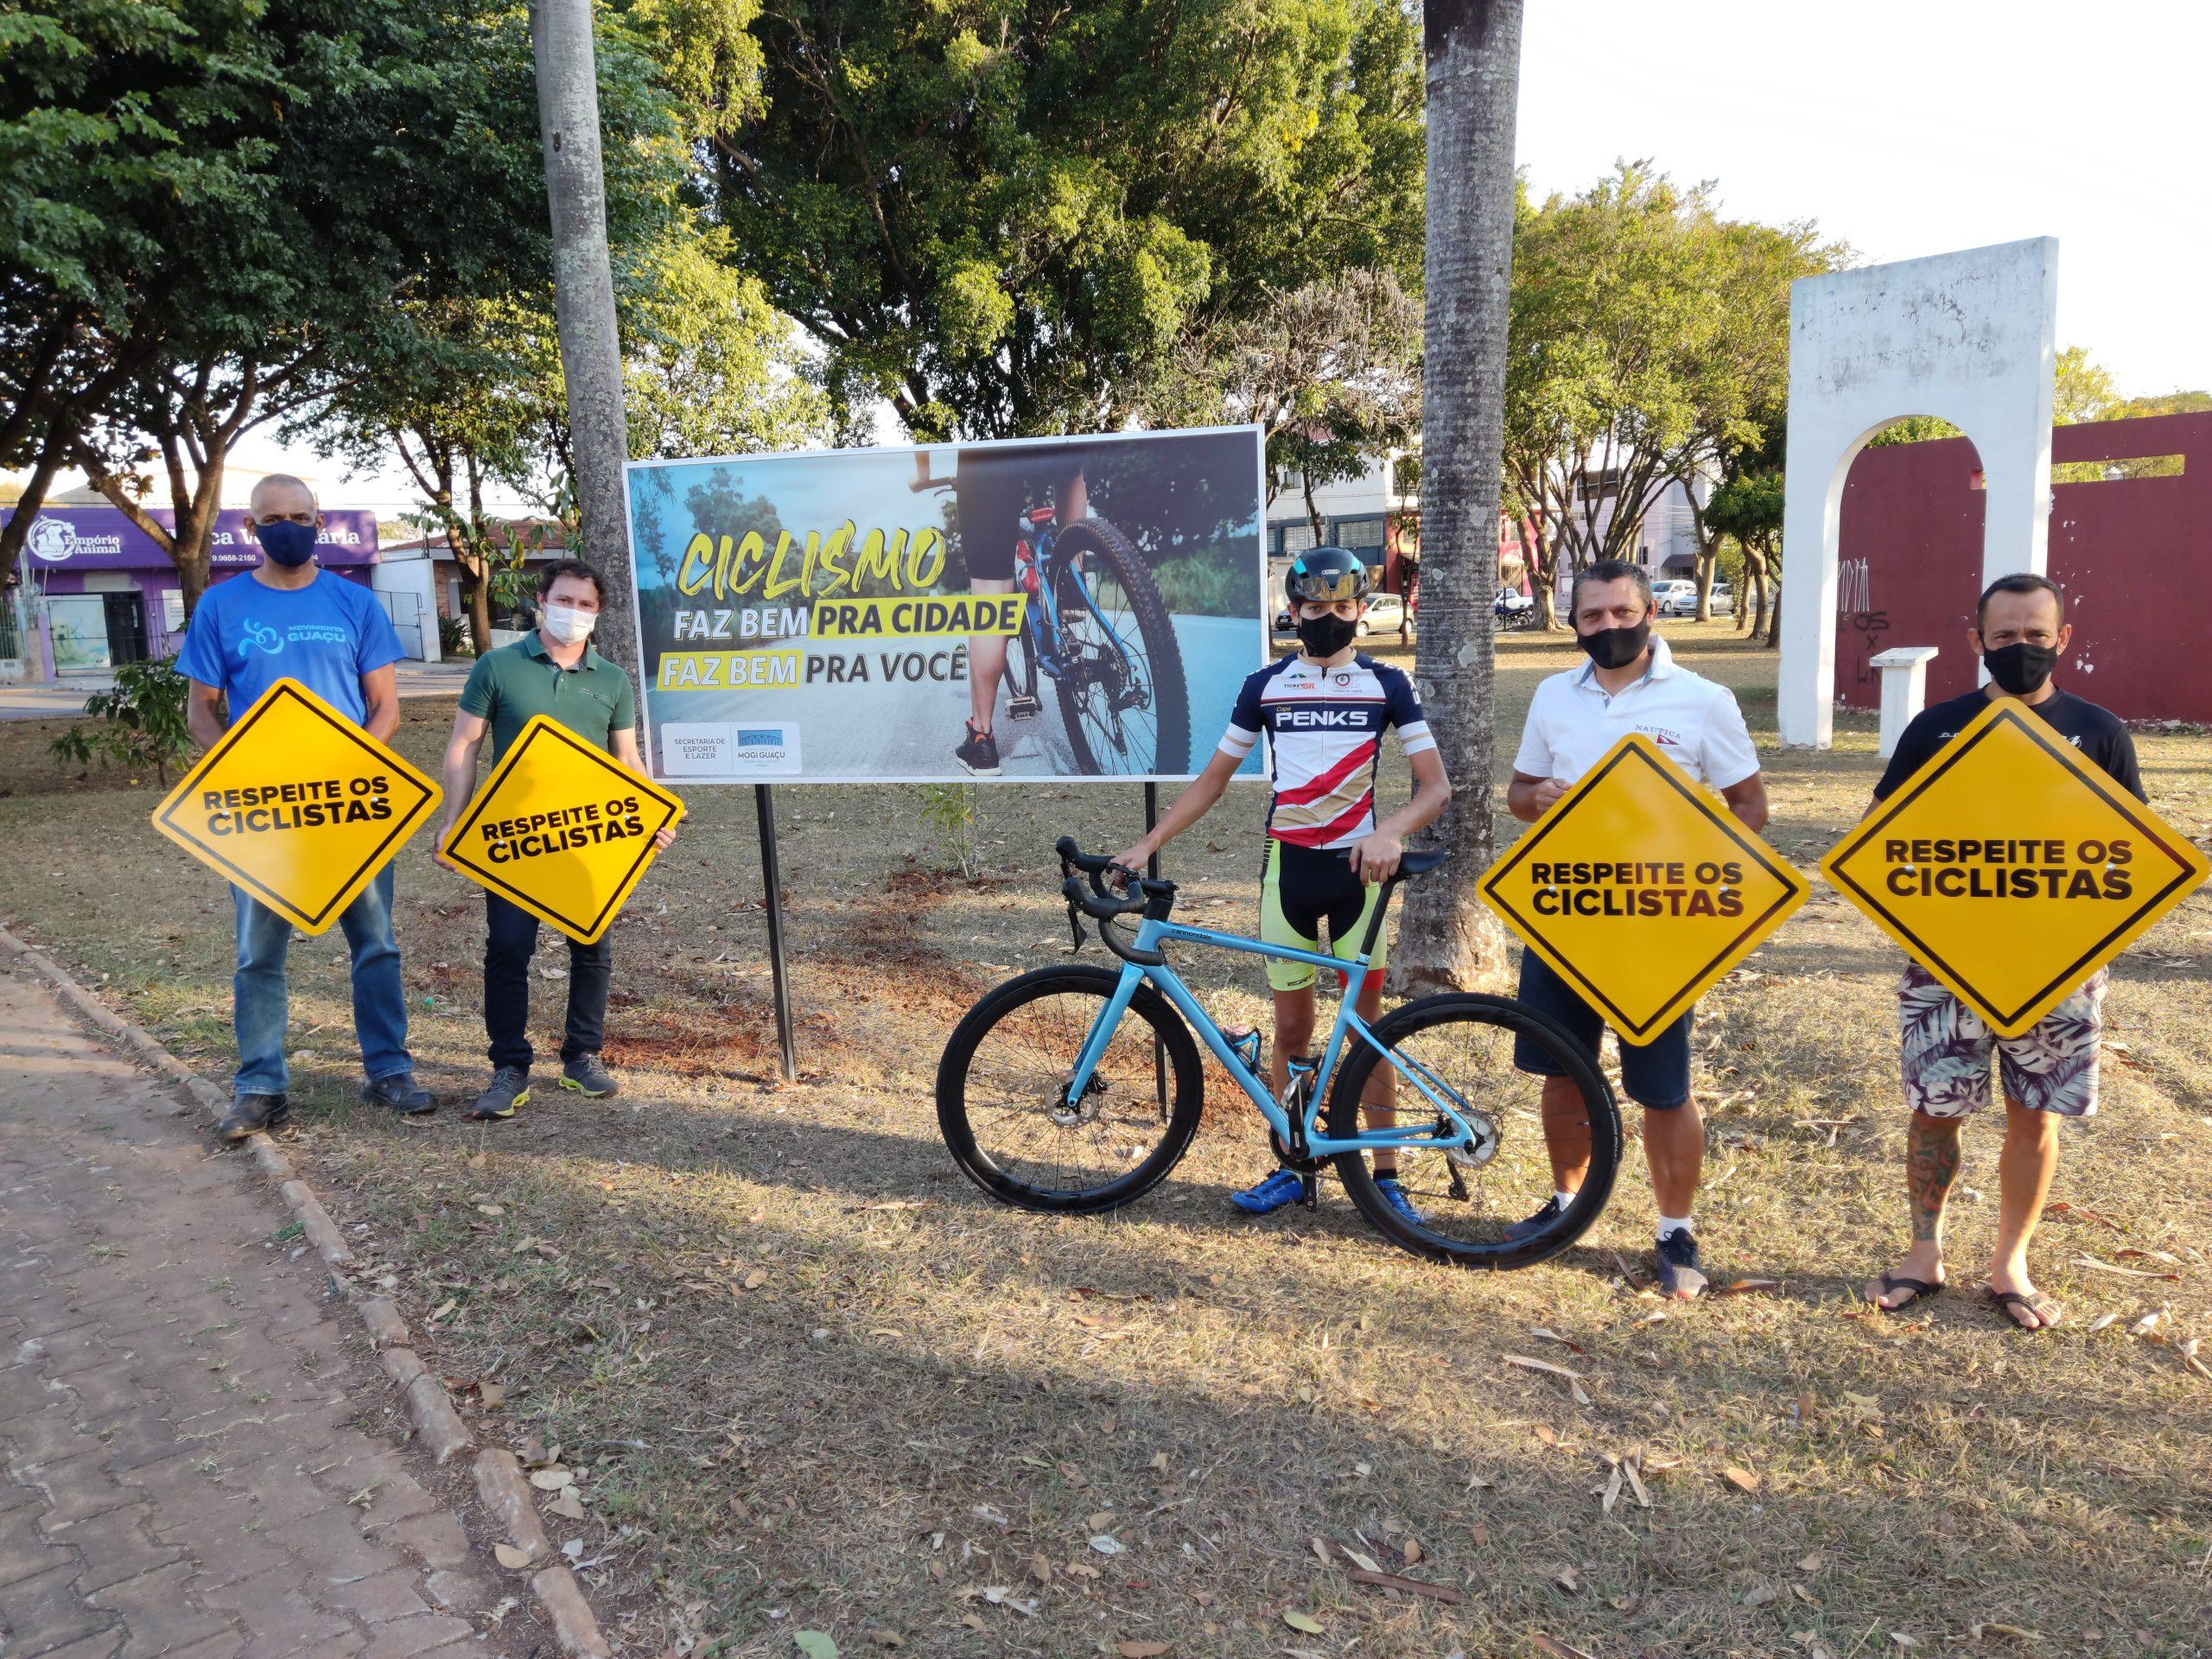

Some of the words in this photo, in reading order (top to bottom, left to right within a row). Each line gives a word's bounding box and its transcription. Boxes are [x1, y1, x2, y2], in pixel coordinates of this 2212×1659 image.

[64, 535, 120, 547] Empório
[74, 543, 121, 554] Animal
[677, 518, 947, 600] CICLISMO
[674, 608, 733, 640] FAZ
[739, 606, 809, 639] BEM
[817, 604, 884, 635] PRA
[892, 601, 1020, 632] CIDADE
[288, 632, 346, 642] GUAÇU
[663, 657, 721, 686] FAZ
[728, 655, 797, 685] BEM
[805, 653, 871, 683] PRA
[880, 644, 969, 683] VOCÊ
[1275, 710, 1369, 727] PENKS
[1636, 725, 1681, 740] NAUTICA
[759, 751, 785, 760] GUAÇU
[203, 779, 341, 810] RESPEITE
[349, 776, 389, 796] OS
[207, 798, 392, 836] CICLISTAS
[481, 804, 600, 841] RESPEITE
[605, 796, 639, 817] OS
[487, 816, 644, 863] CICLISTAS
[1885, 839, 2065, 863] RESPEITE
[2076, 839, 2133, 865] OS
[1531, 862, 1685, 885] RESPEITE
[1694, 861, 1744, 885] OS
[1886, 867, 2133, 900] CICLISTAS
[1532, 888, 1745, 918] CICLISTAS
[1172, 927, 1213, 941] cannondale
